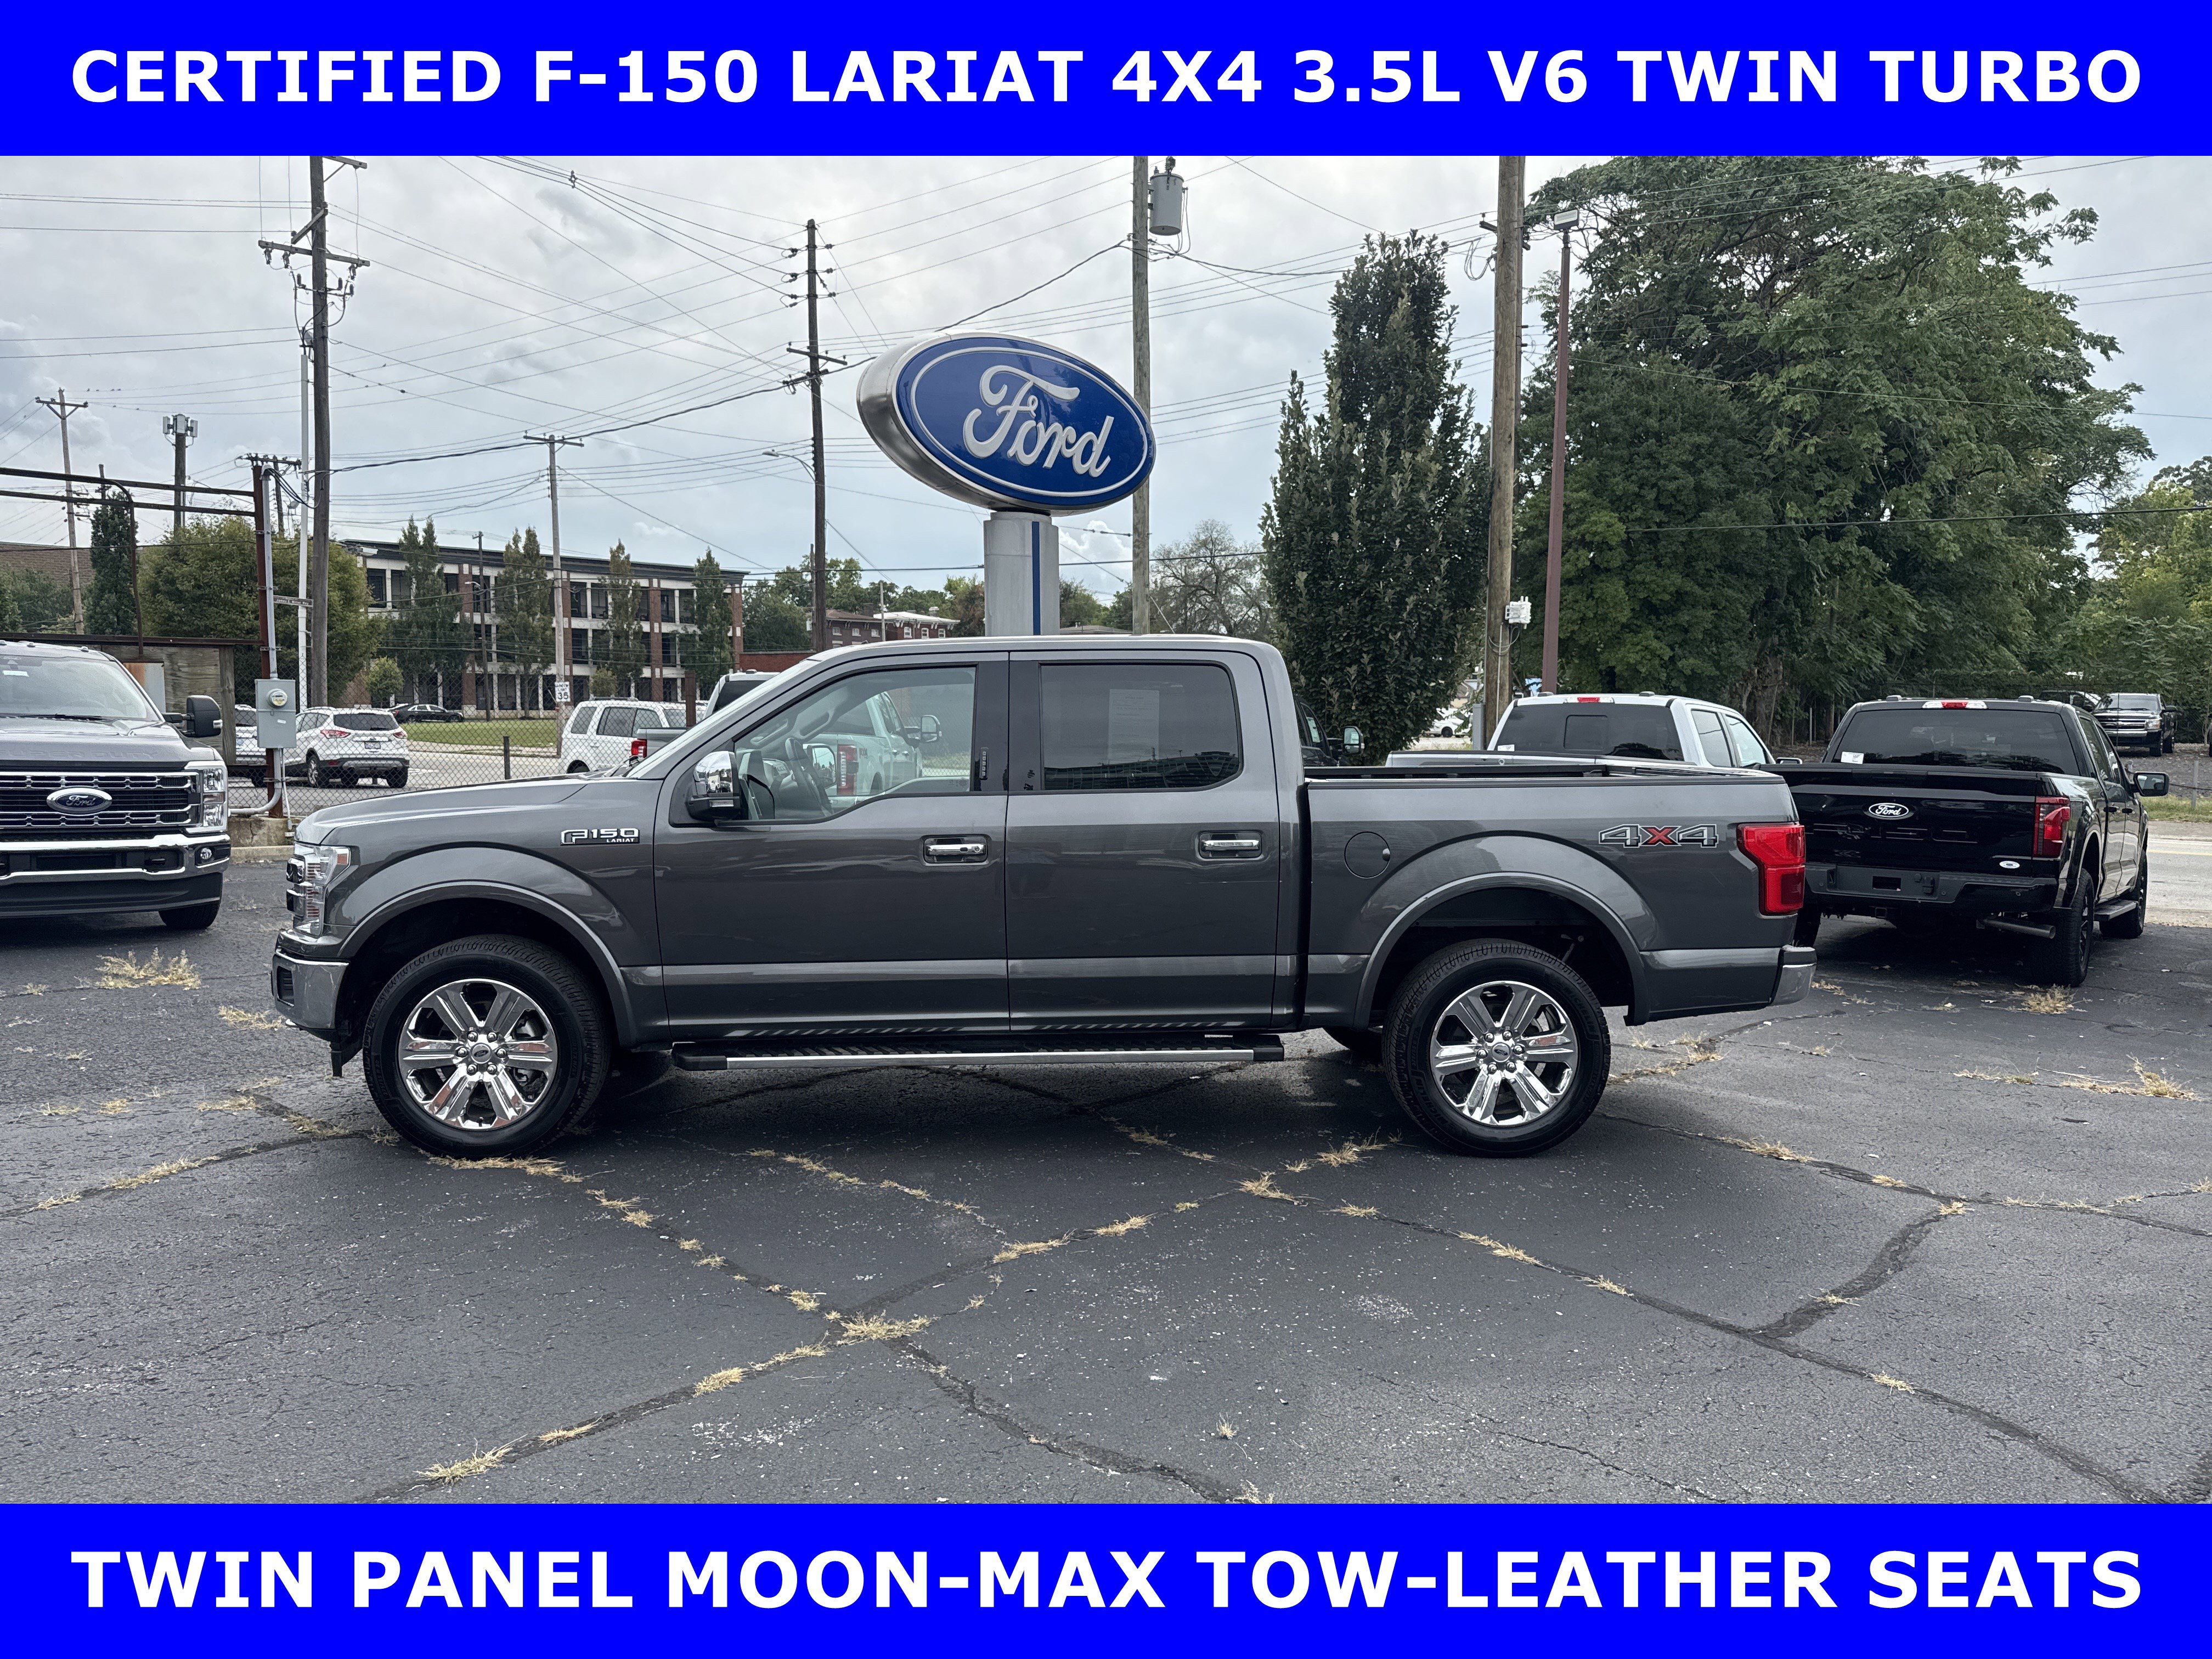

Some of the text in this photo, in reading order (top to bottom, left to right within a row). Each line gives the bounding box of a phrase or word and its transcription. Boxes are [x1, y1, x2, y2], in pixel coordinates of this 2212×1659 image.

[963, 365, 1114, 478] Ford
[66, 795, 96, 806] Ford
[1875, 804, 1902, 815] Ford
[561, 828, 639, 844] F150
